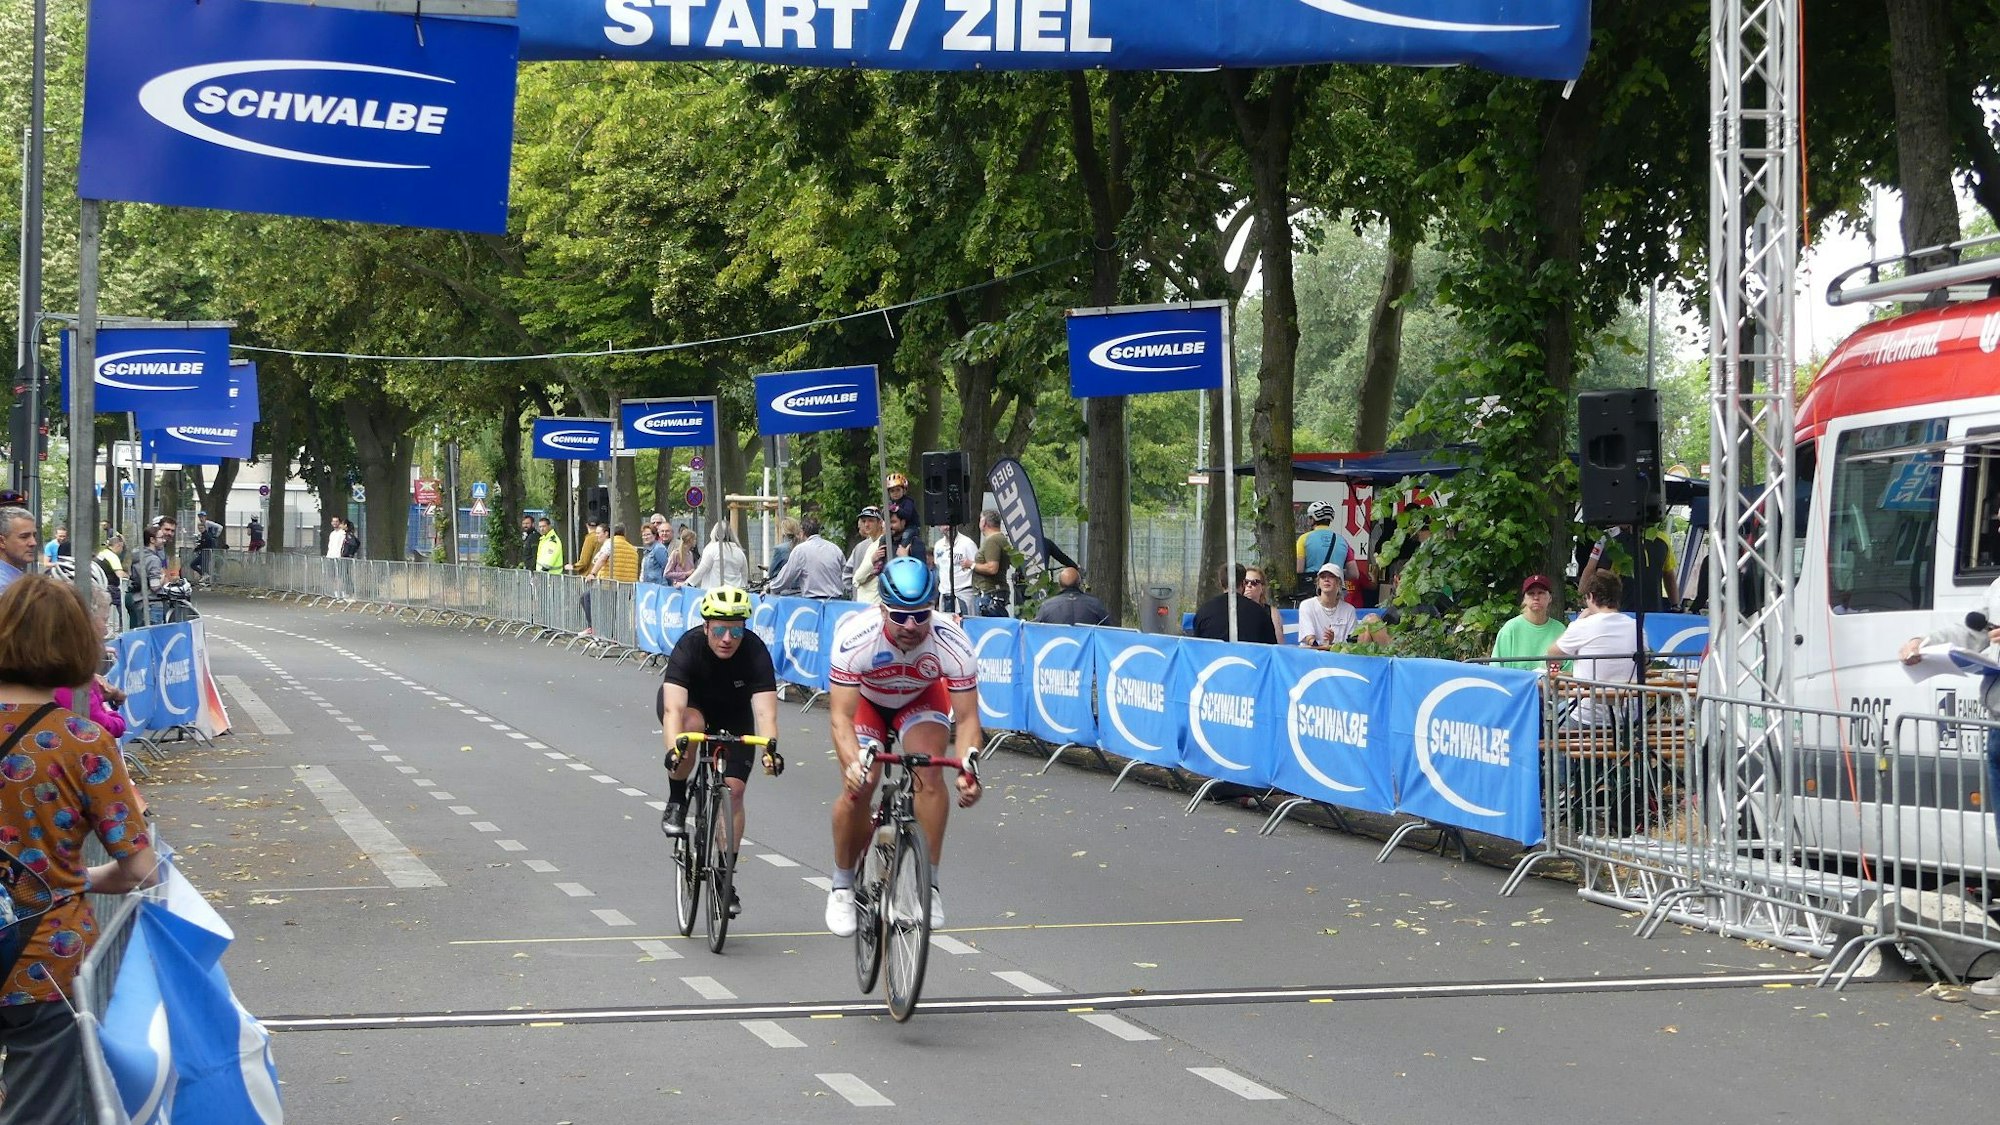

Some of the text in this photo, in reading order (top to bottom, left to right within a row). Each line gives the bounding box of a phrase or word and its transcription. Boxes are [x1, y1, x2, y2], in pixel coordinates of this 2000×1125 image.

[603, 0, 1113, 52] START / ZIEL
[194, 86, 448, 135] SCHWALBE
[1109, 341, 1205, 359] SCHWALBE
[103, 362, 204, 376] SCHWALBE
[786, 392, 858, 407] SCHWALBE
[178, 426, 238, 438] SCHWALBE
[551, 434, 600, 445] SCHWALBE
[645, 417, 703, 428] SCHWALBE
[1039, 667, 1081, 697] SCHWALBE
[1116, 675, 1165, 713] SCHWALBE
[1200, 691, 1255, 729] SCHWALBE
[1298, 703, 1368, 748] SCHWALBE
[1850, 697, 1891, 747] ROSE
[1430, 718, 1510, 767] SCHWALBE
